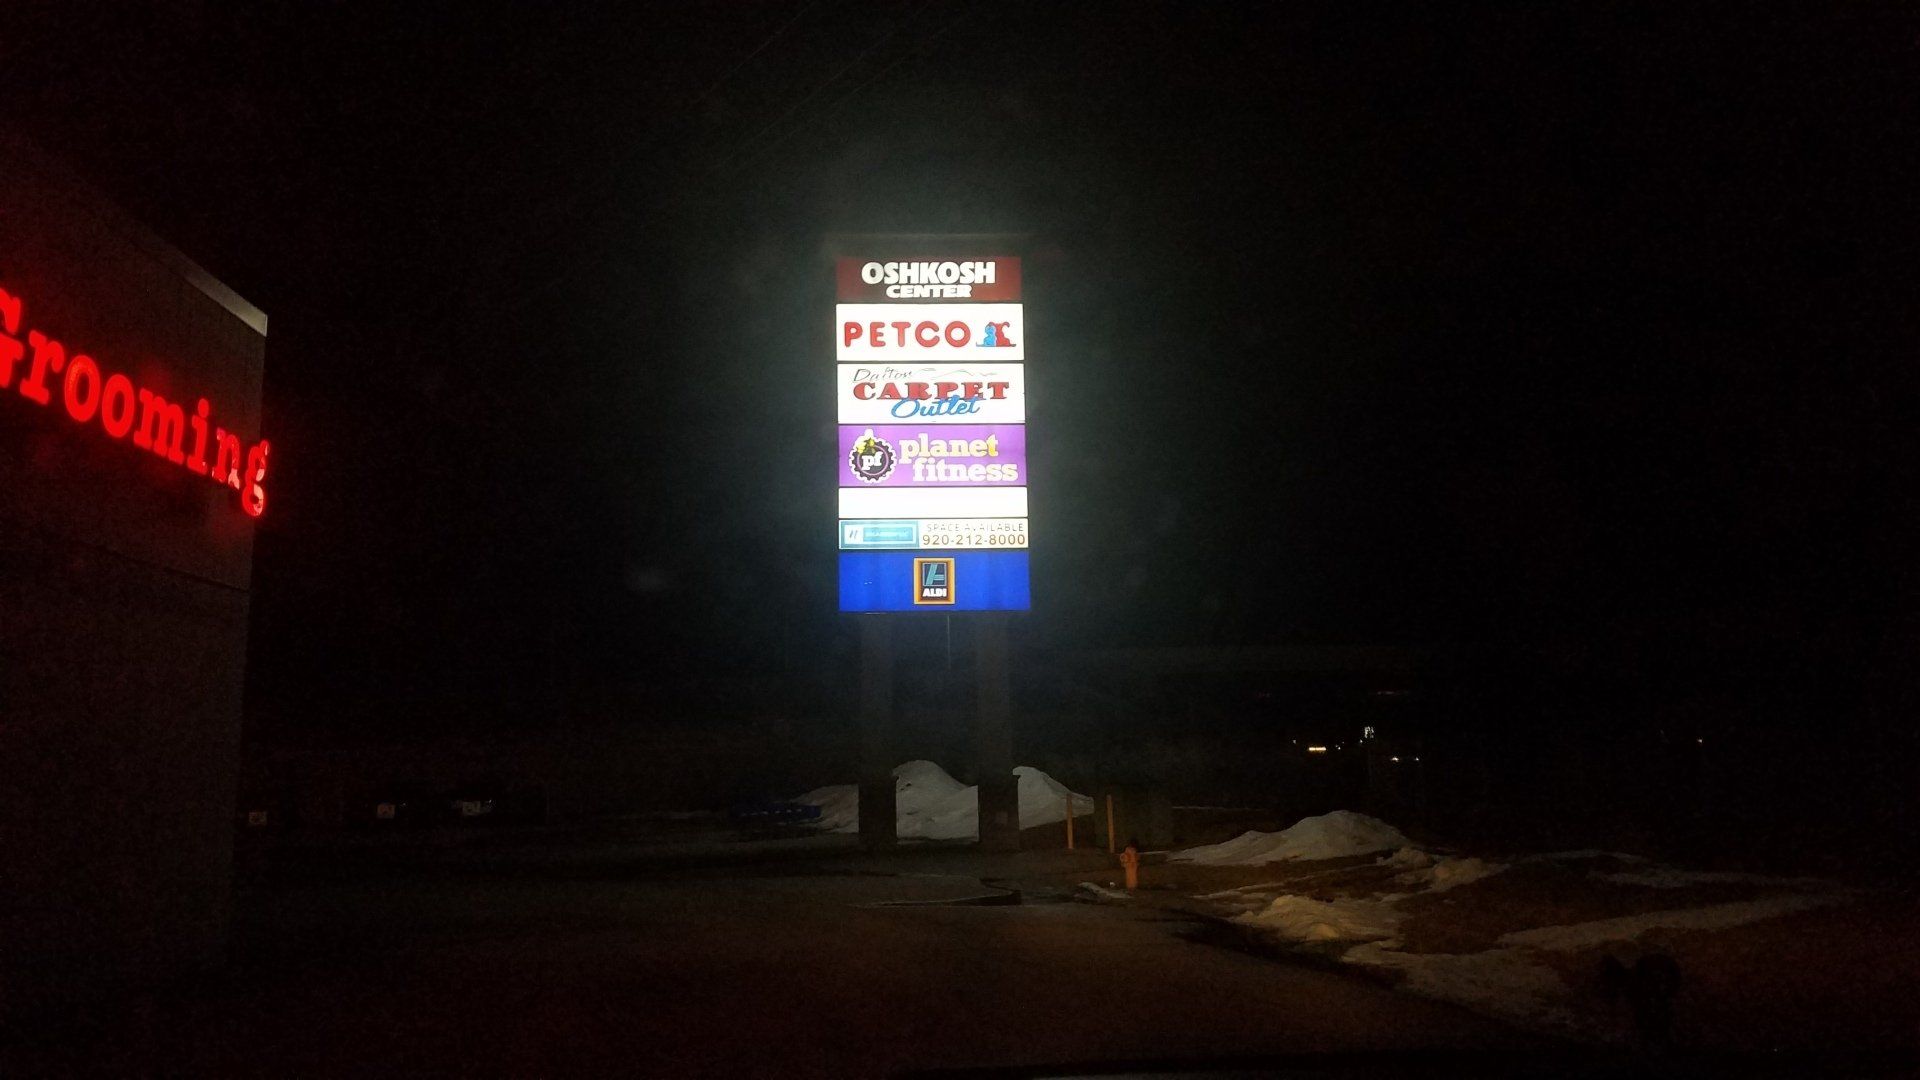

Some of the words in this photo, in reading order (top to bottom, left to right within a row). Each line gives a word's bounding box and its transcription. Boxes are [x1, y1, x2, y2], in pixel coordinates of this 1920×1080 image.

[861, 261, 996, 285] OSHKOSH
[885, 284, 972, 299] CENTER
[844, 320, 971, 348] PETCO
[853, 381, 1010, 401] CARPET
[891, 394, 981, 419] Outlet
[898, 432, 999, 465] planet
[860, 450, 884, 471] pf
[912, 457, 1019, 482] fitness
[926, 523, 960, 533] SPACE
[964, 523, 1024, 532] AVAILABLE
[922, 534, 1026, 546] 920-212-8000
[922, 588, 948, 598] ALDI
